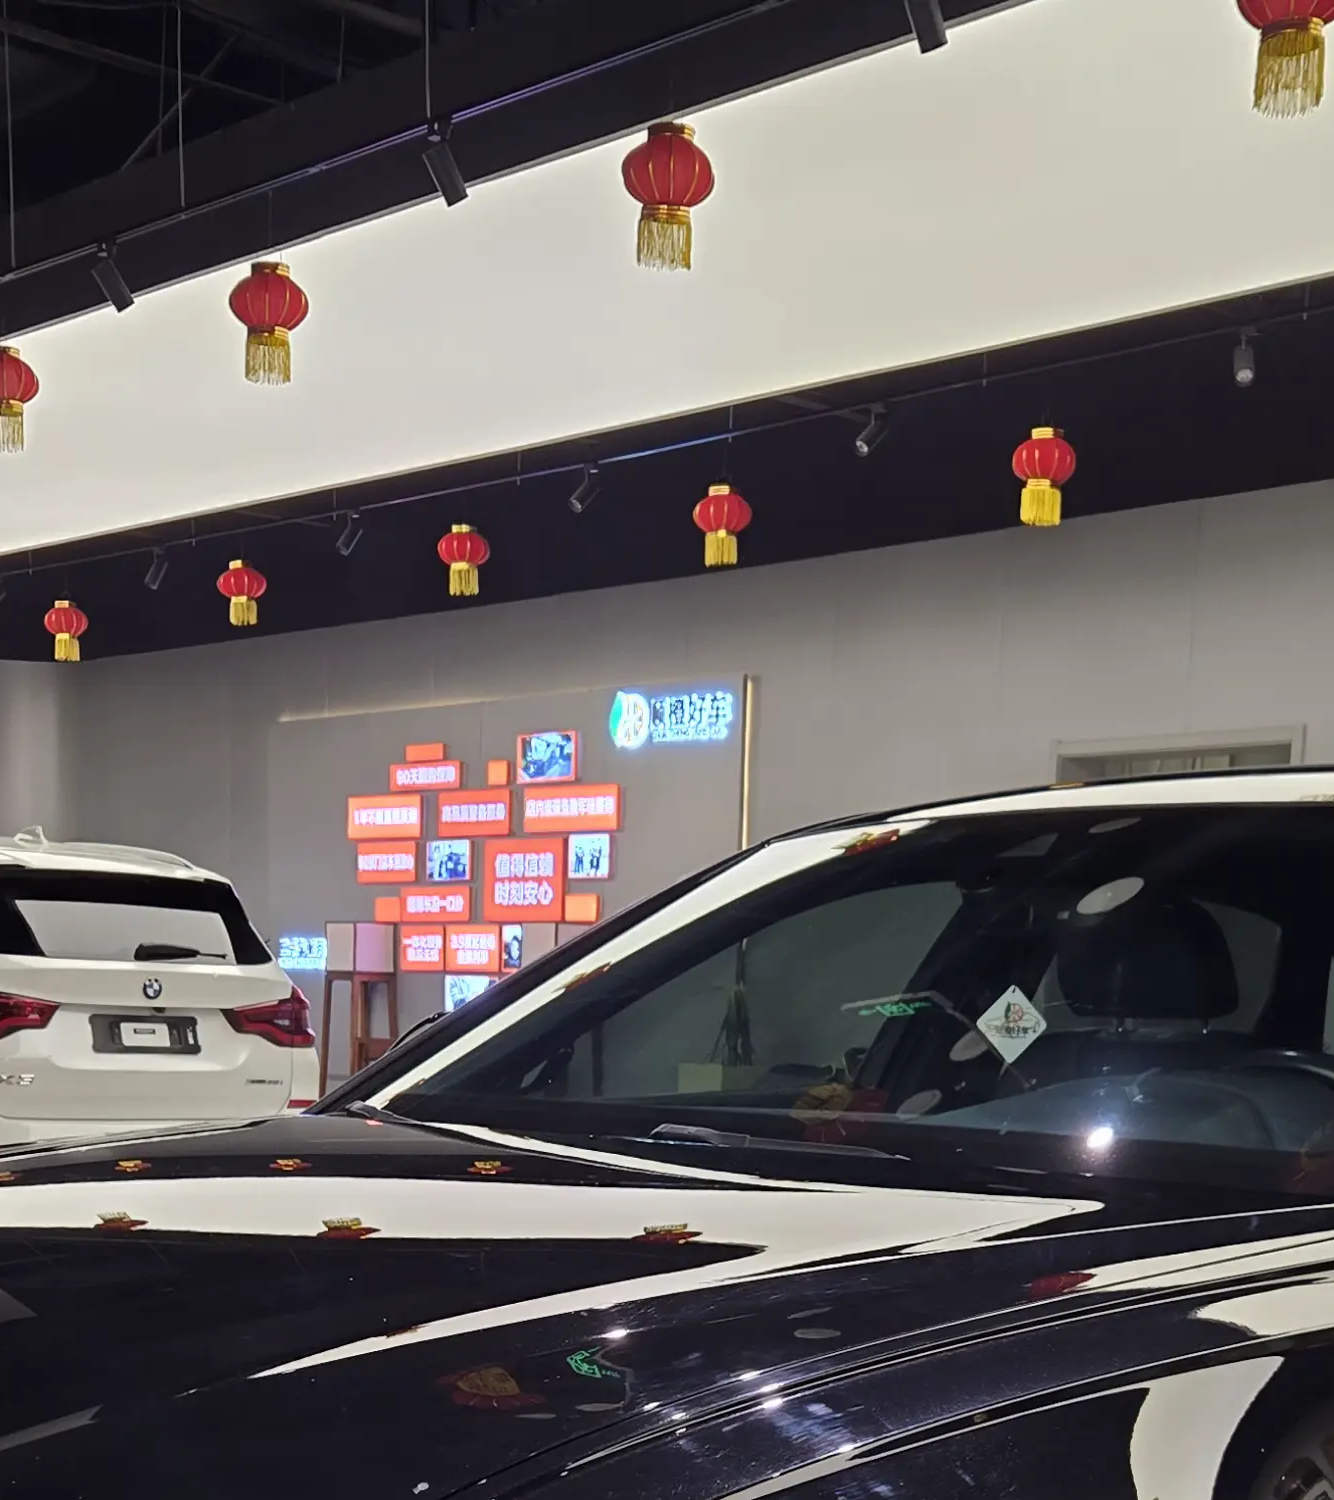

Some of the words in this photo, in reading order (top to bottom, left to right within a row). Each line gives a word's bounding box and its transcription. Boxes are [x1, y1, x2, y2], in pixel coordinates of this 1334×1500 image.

[495, 851, 554, 878] 值得信赖
[494, 880, 554, 906] 时刻安心
